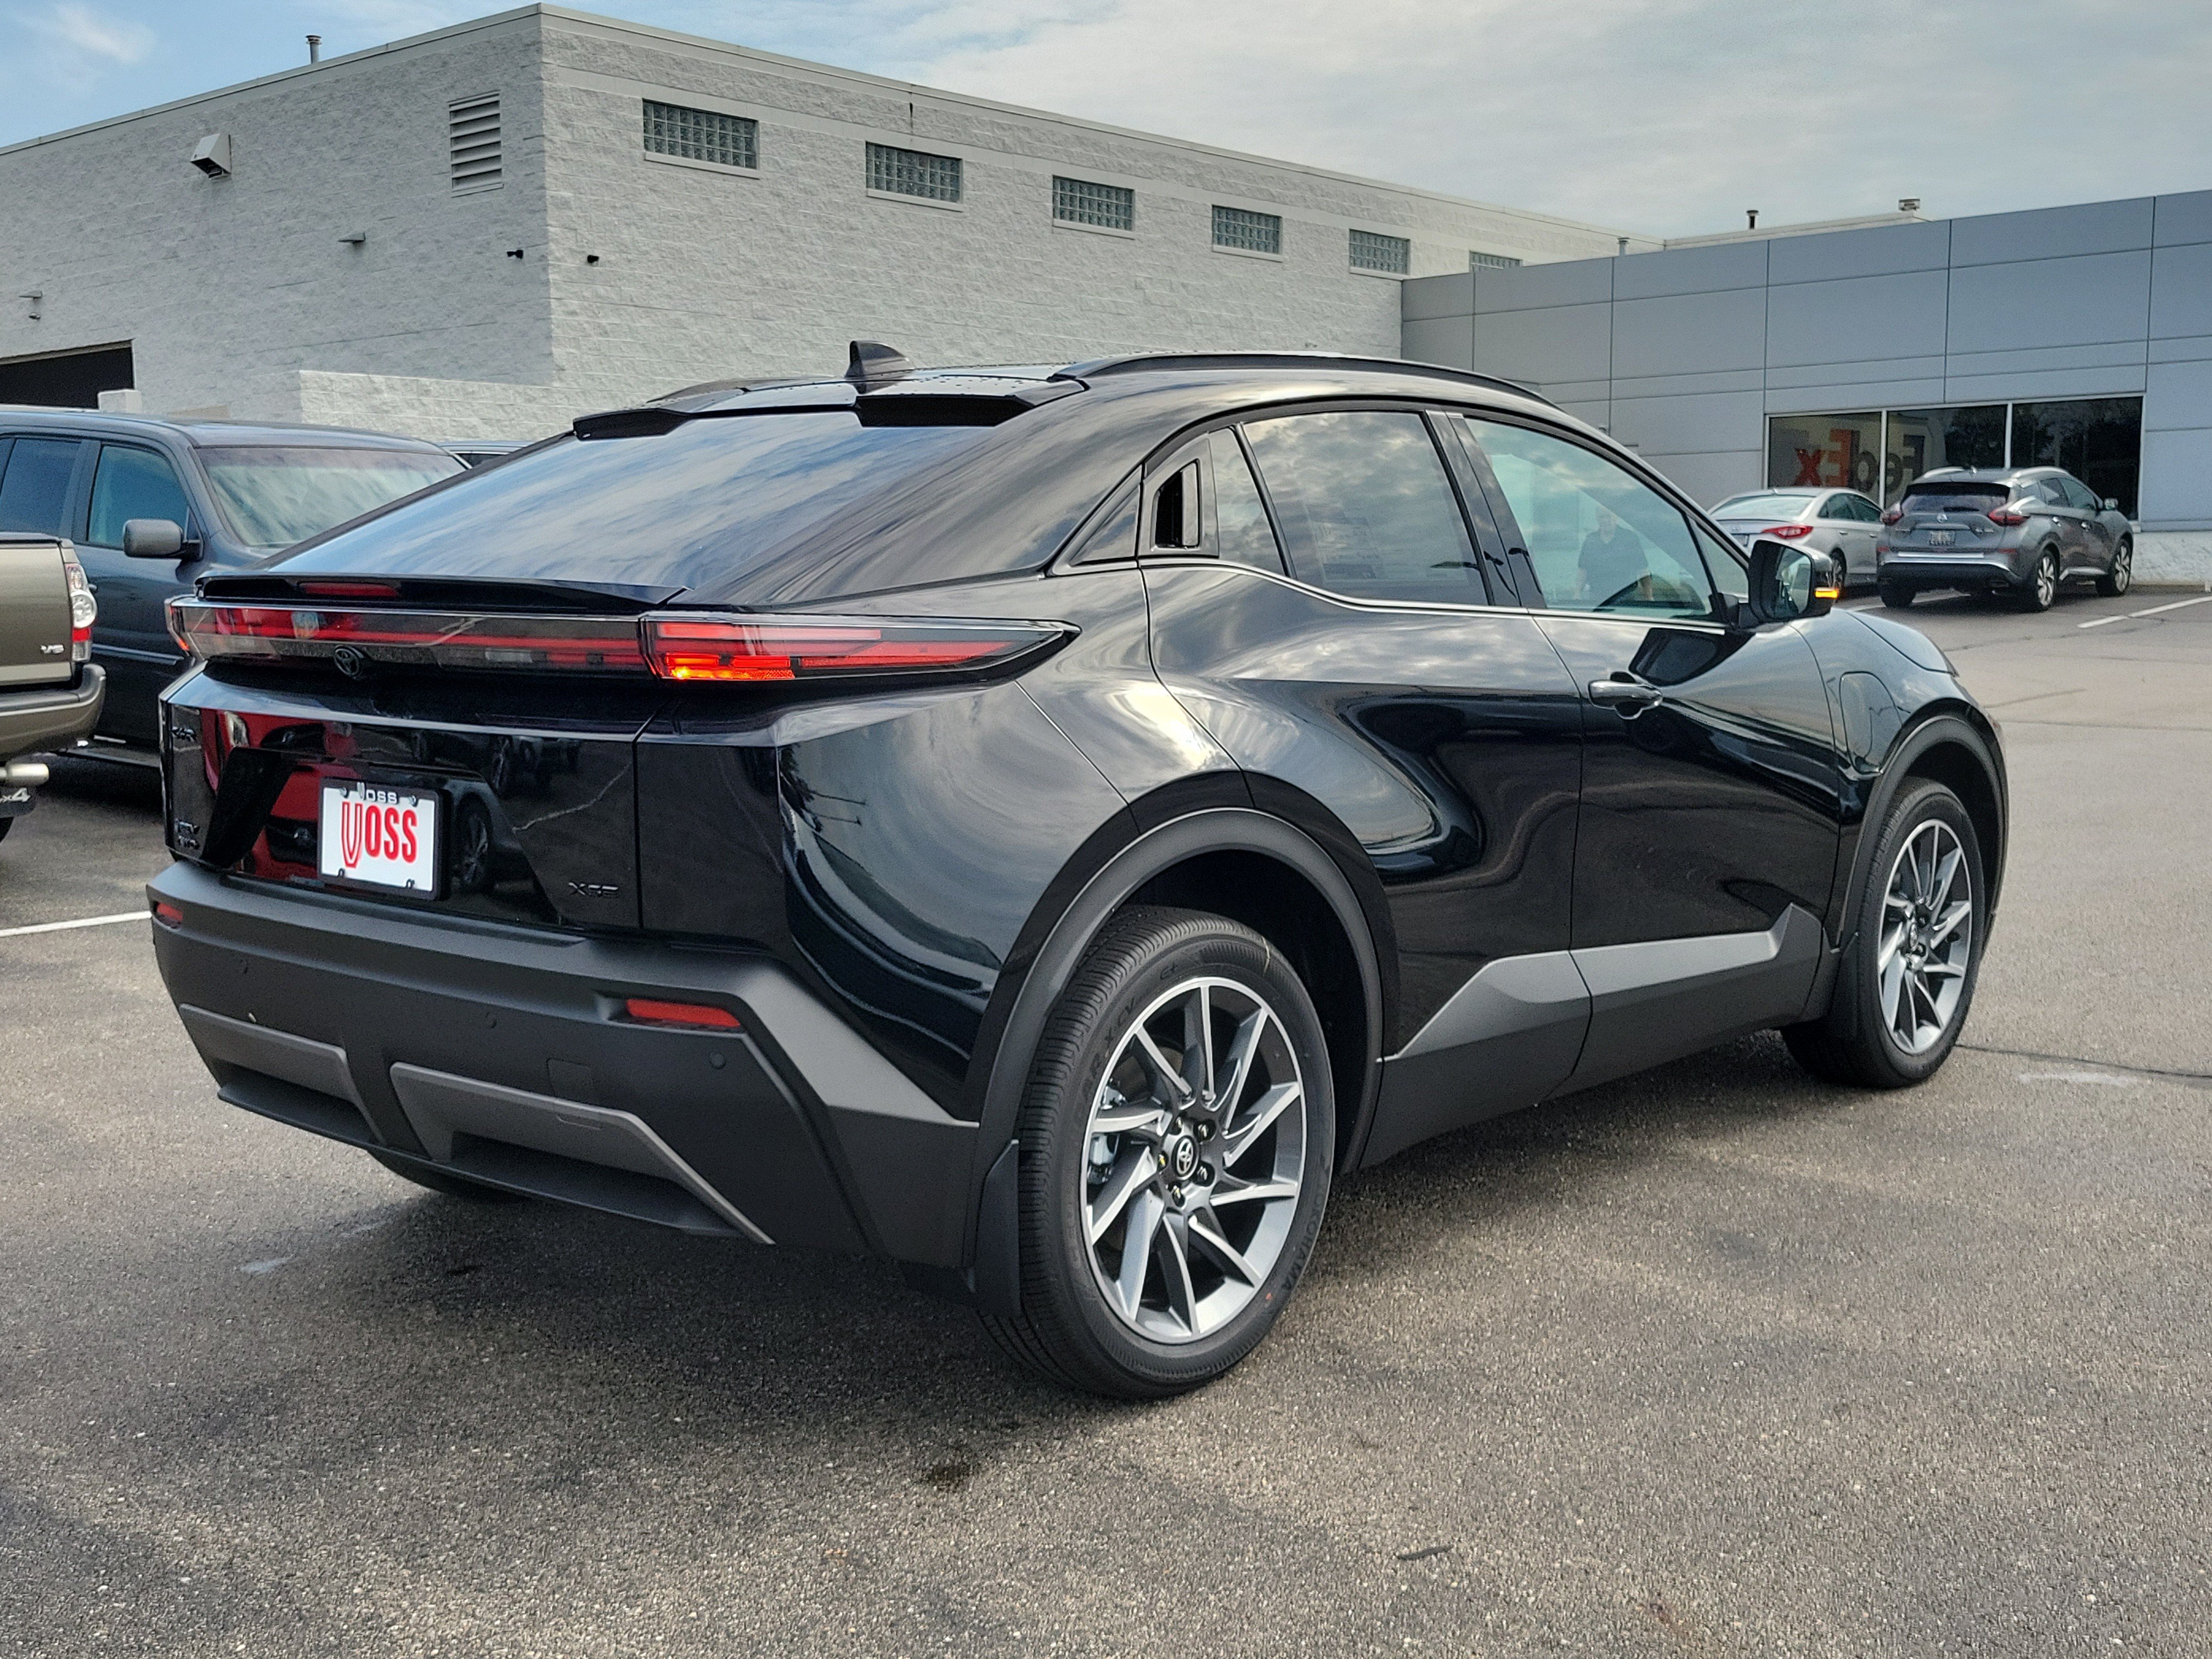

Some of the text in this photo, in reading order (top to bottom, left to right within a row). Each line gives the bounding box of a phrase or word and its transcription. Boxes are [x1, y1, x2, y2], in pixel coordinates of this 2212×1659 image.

[0, 787, 31, 803] x4
[356, 781, 398, 805] VOSS
[341, 801, 417, 868] VOSS
